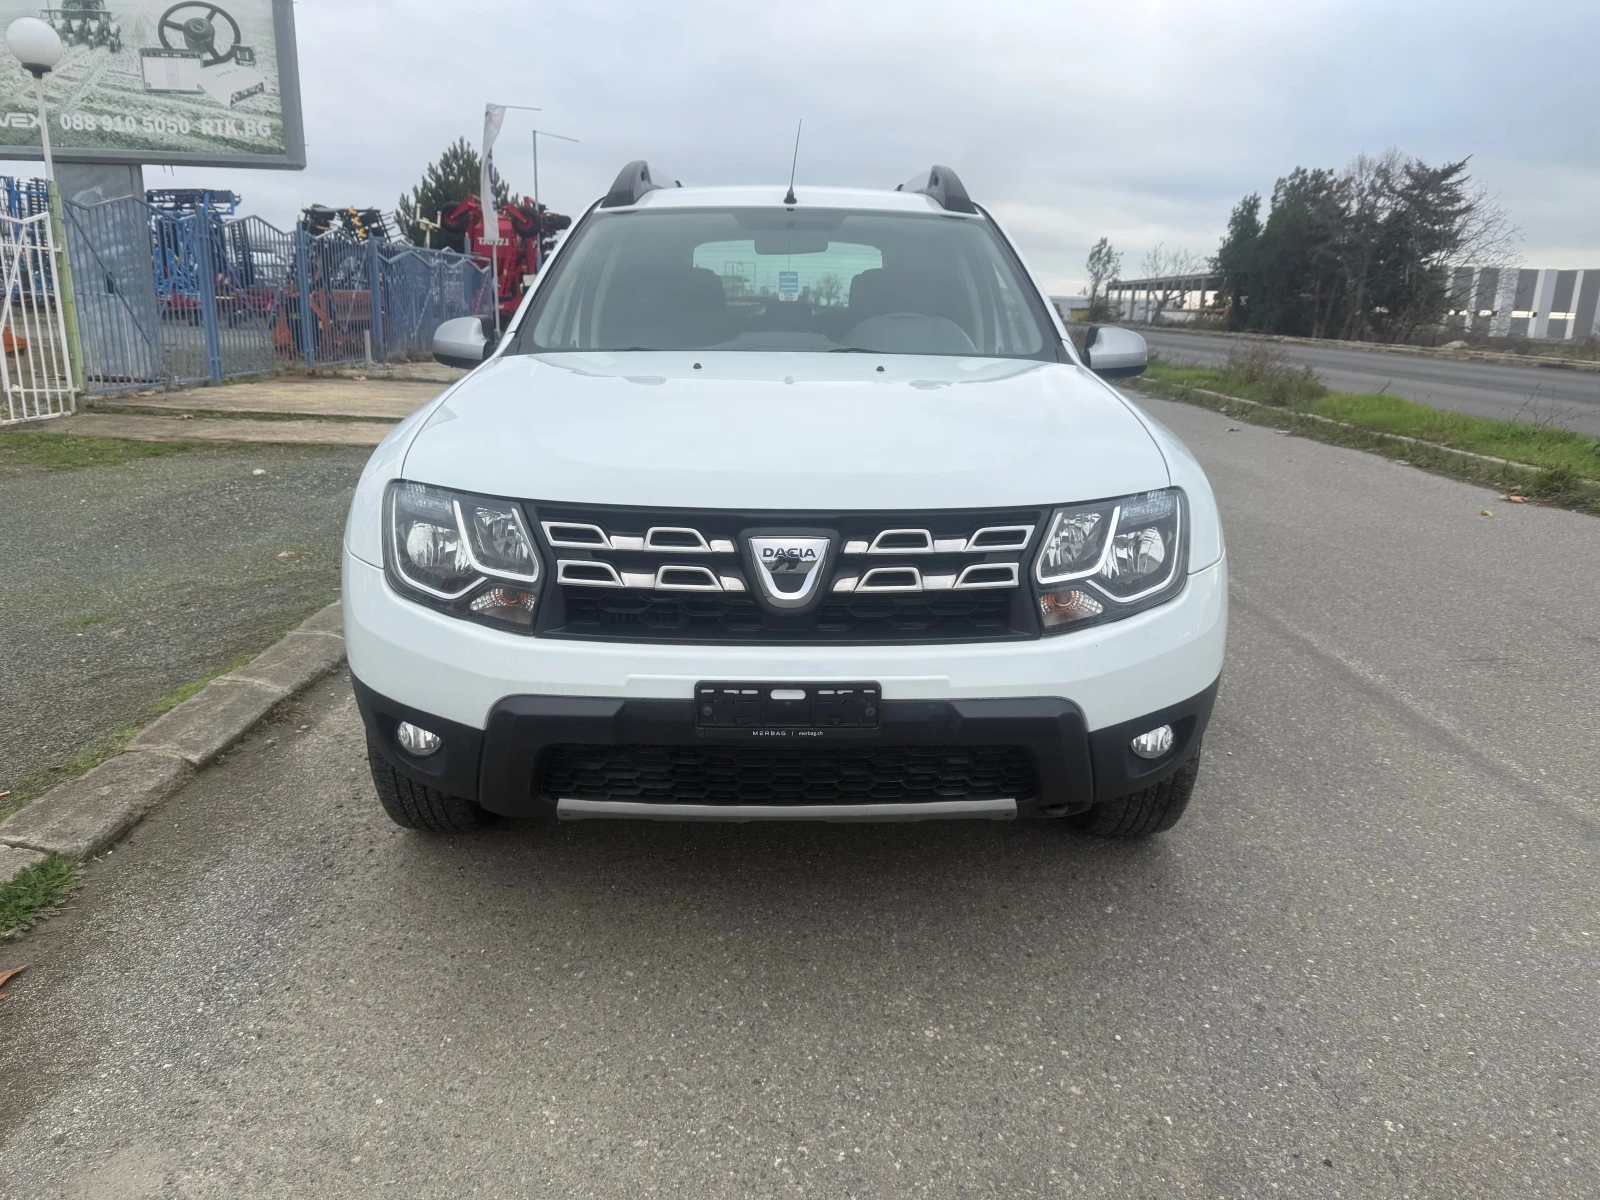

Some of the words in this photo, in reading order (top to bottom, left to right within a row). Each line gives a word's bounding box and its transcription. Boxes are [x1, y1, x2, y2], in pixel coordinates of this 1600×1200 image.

[60, 113, 96, 131] 088
[102, 114, 137, 132] 910
[142, 116, 190, 135] 5050
[200, 118, 271, 138] RTK.BG
[763, 547, 816, 558] DACIA
